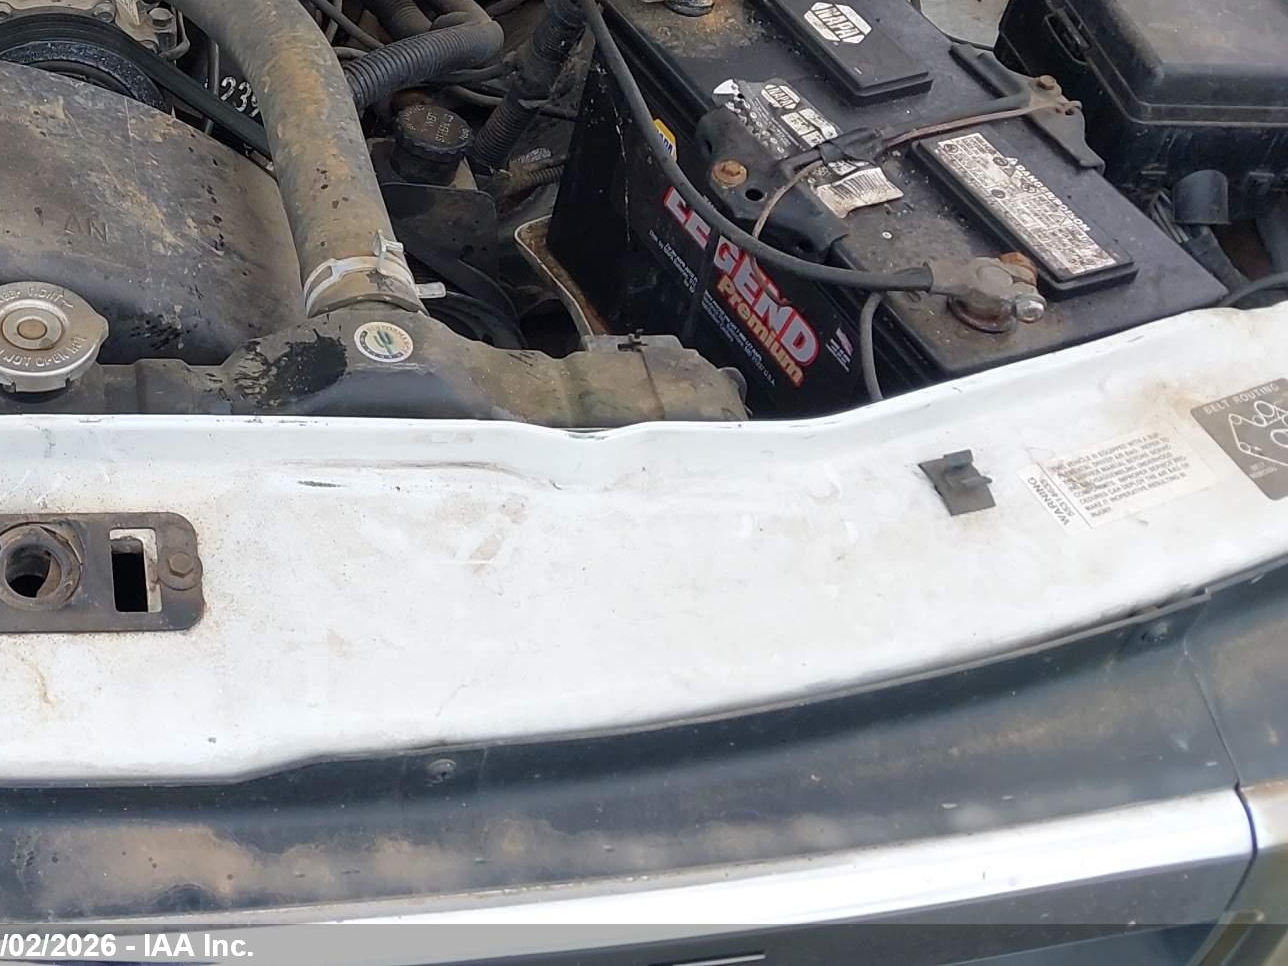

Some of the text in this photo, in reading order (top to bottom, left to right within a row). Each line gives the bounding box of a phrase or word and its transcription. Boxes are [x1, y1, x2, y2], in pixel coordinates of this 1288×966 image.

[718, 274, 805, 386] Premium
[1203, 383, 1280, 414] BELT ROUTING
[1027, 477, 1070, 525] WARNING
